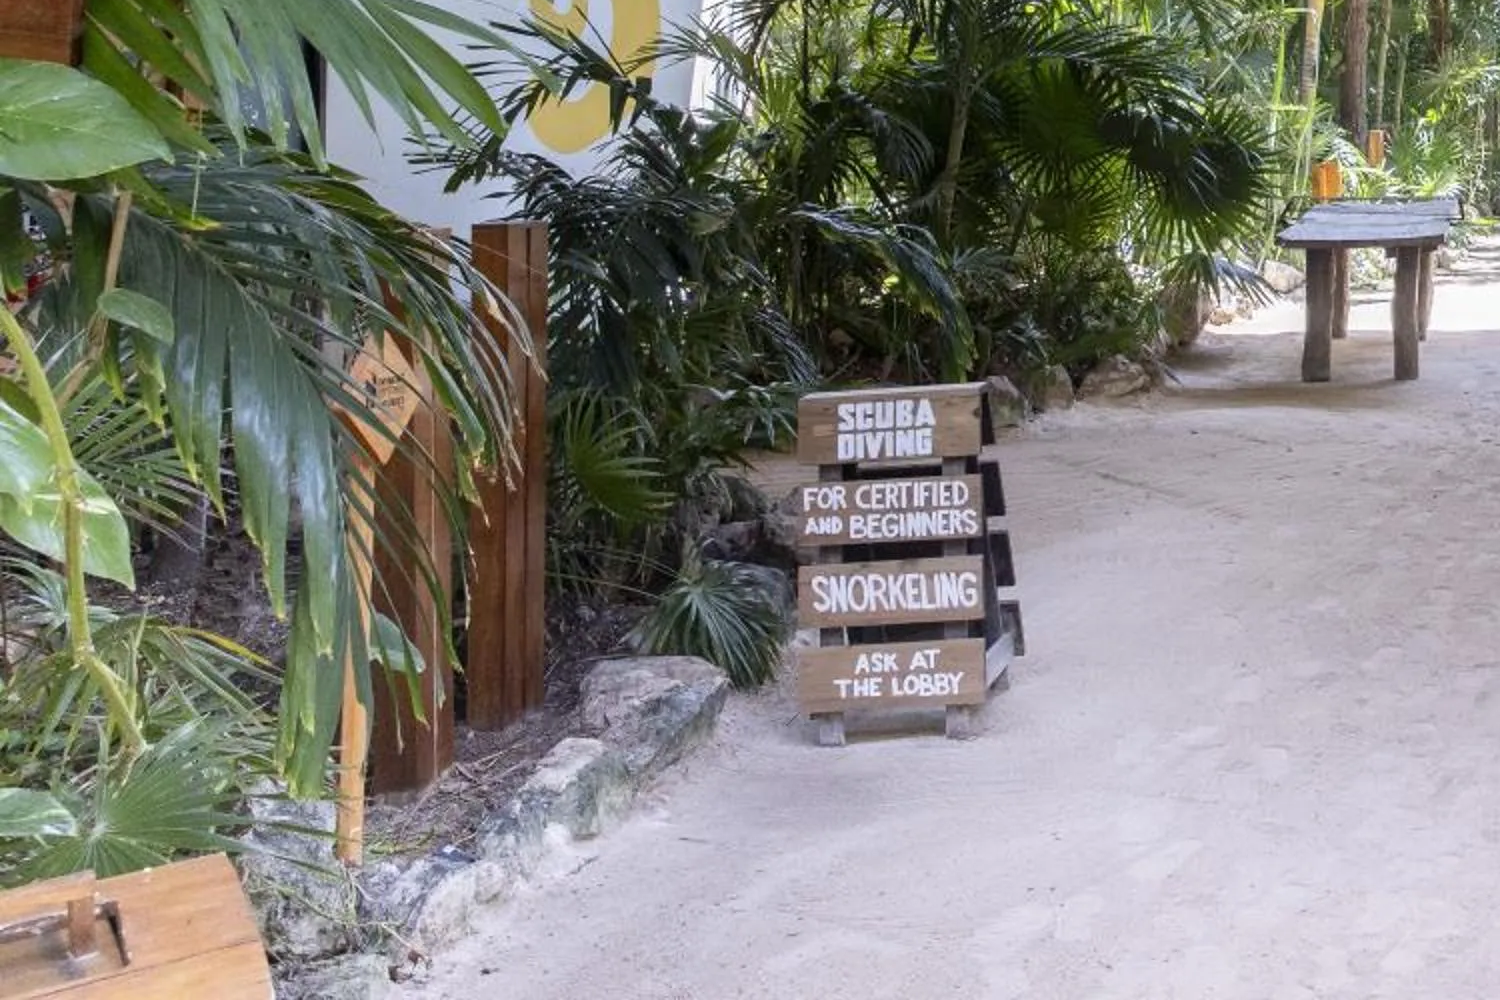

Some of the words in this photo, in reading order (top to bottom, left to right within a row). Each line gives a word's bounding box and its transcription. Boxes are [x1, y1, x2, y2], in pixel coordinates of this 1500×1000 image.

[837, 398, 936, 431] SCUBA
[837, 427, 932, 460] DIVING
[803, 486, 847, 511] FOR
[855, 480, 969, 509] CERTIFIED
[805, 516, 842, 535] AND
[850, 509, 979, 539] BEGINNERS
[811, 571, 977, 613] SNORKELING
[854, 652, 898, 675] ASK
[909, 649, 941, 670] AT
[833, 677, 882, 699] THE
[891, 671, 965, 697] LOBBY
